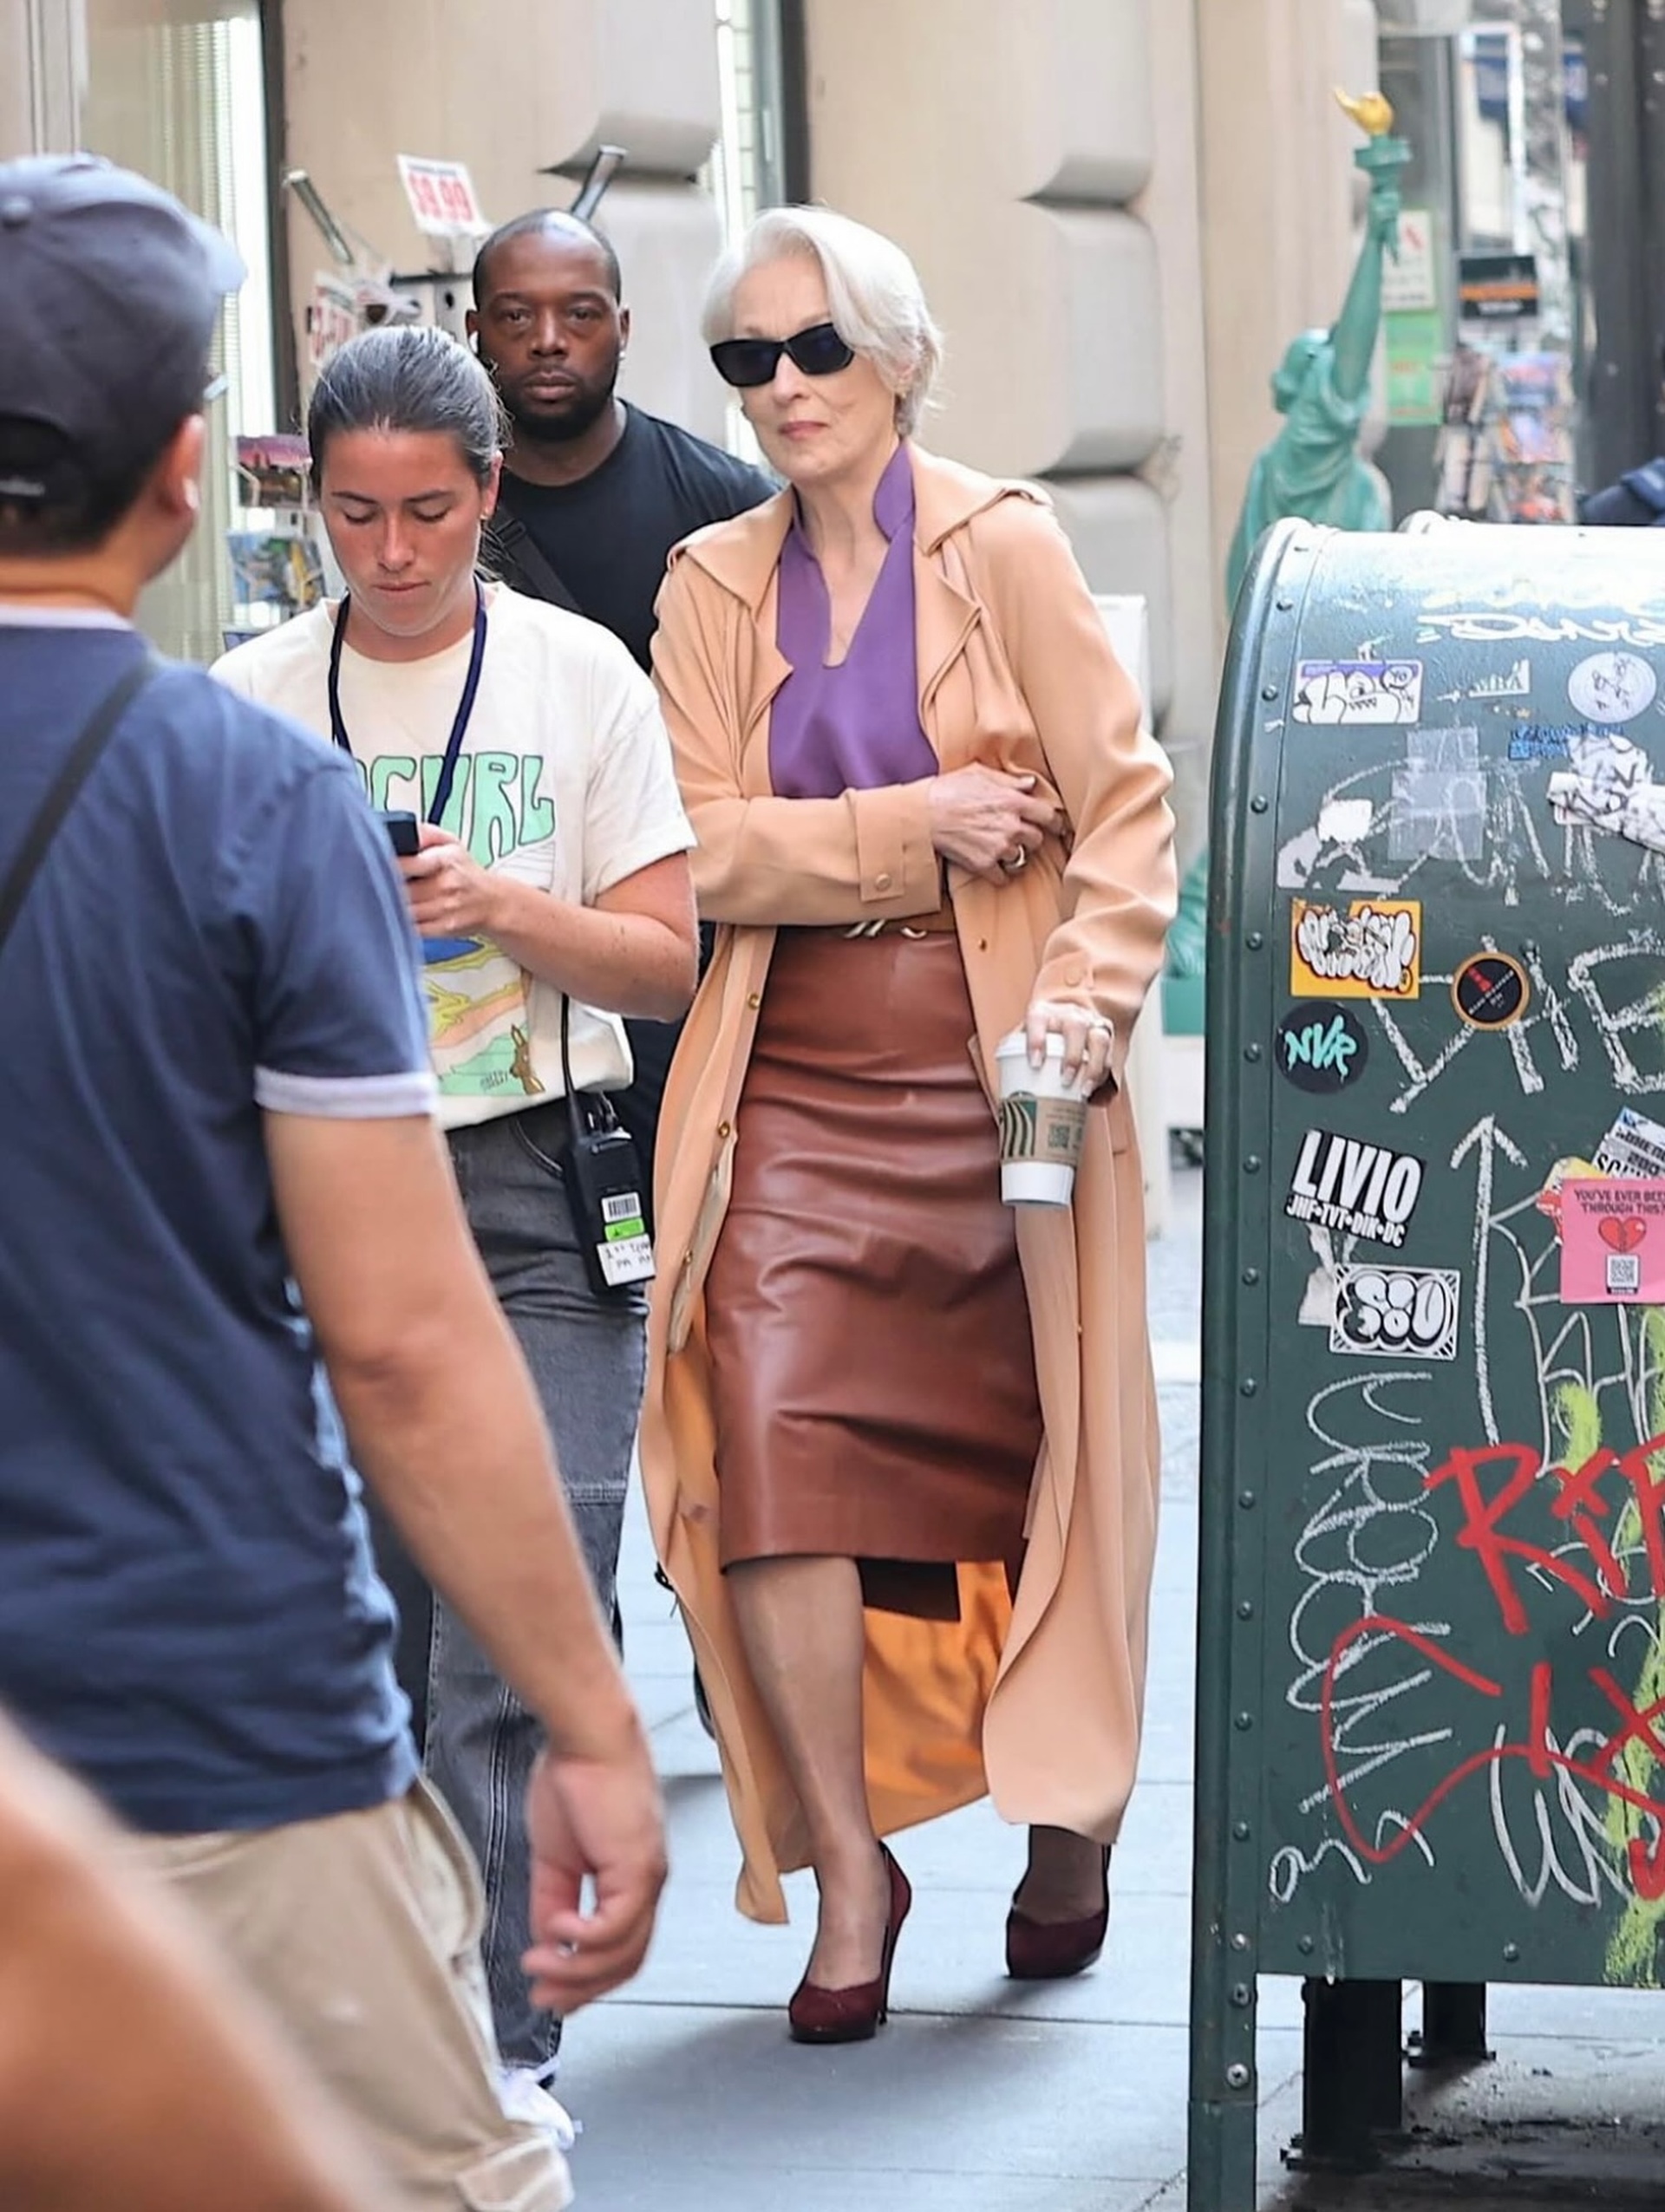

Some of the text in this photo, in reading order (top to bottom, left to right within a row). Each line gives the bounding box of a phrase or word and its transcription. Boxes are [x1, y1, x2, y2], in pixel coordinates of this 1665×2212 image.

[1292, 1129, 1421, 1223] LIVIO
[1574, 1189, 1611, 1202] YOU'VE
[1615, 1190, 1641, 1203] EVER
[1581, 1202, 1633, 1214] THROUGH
